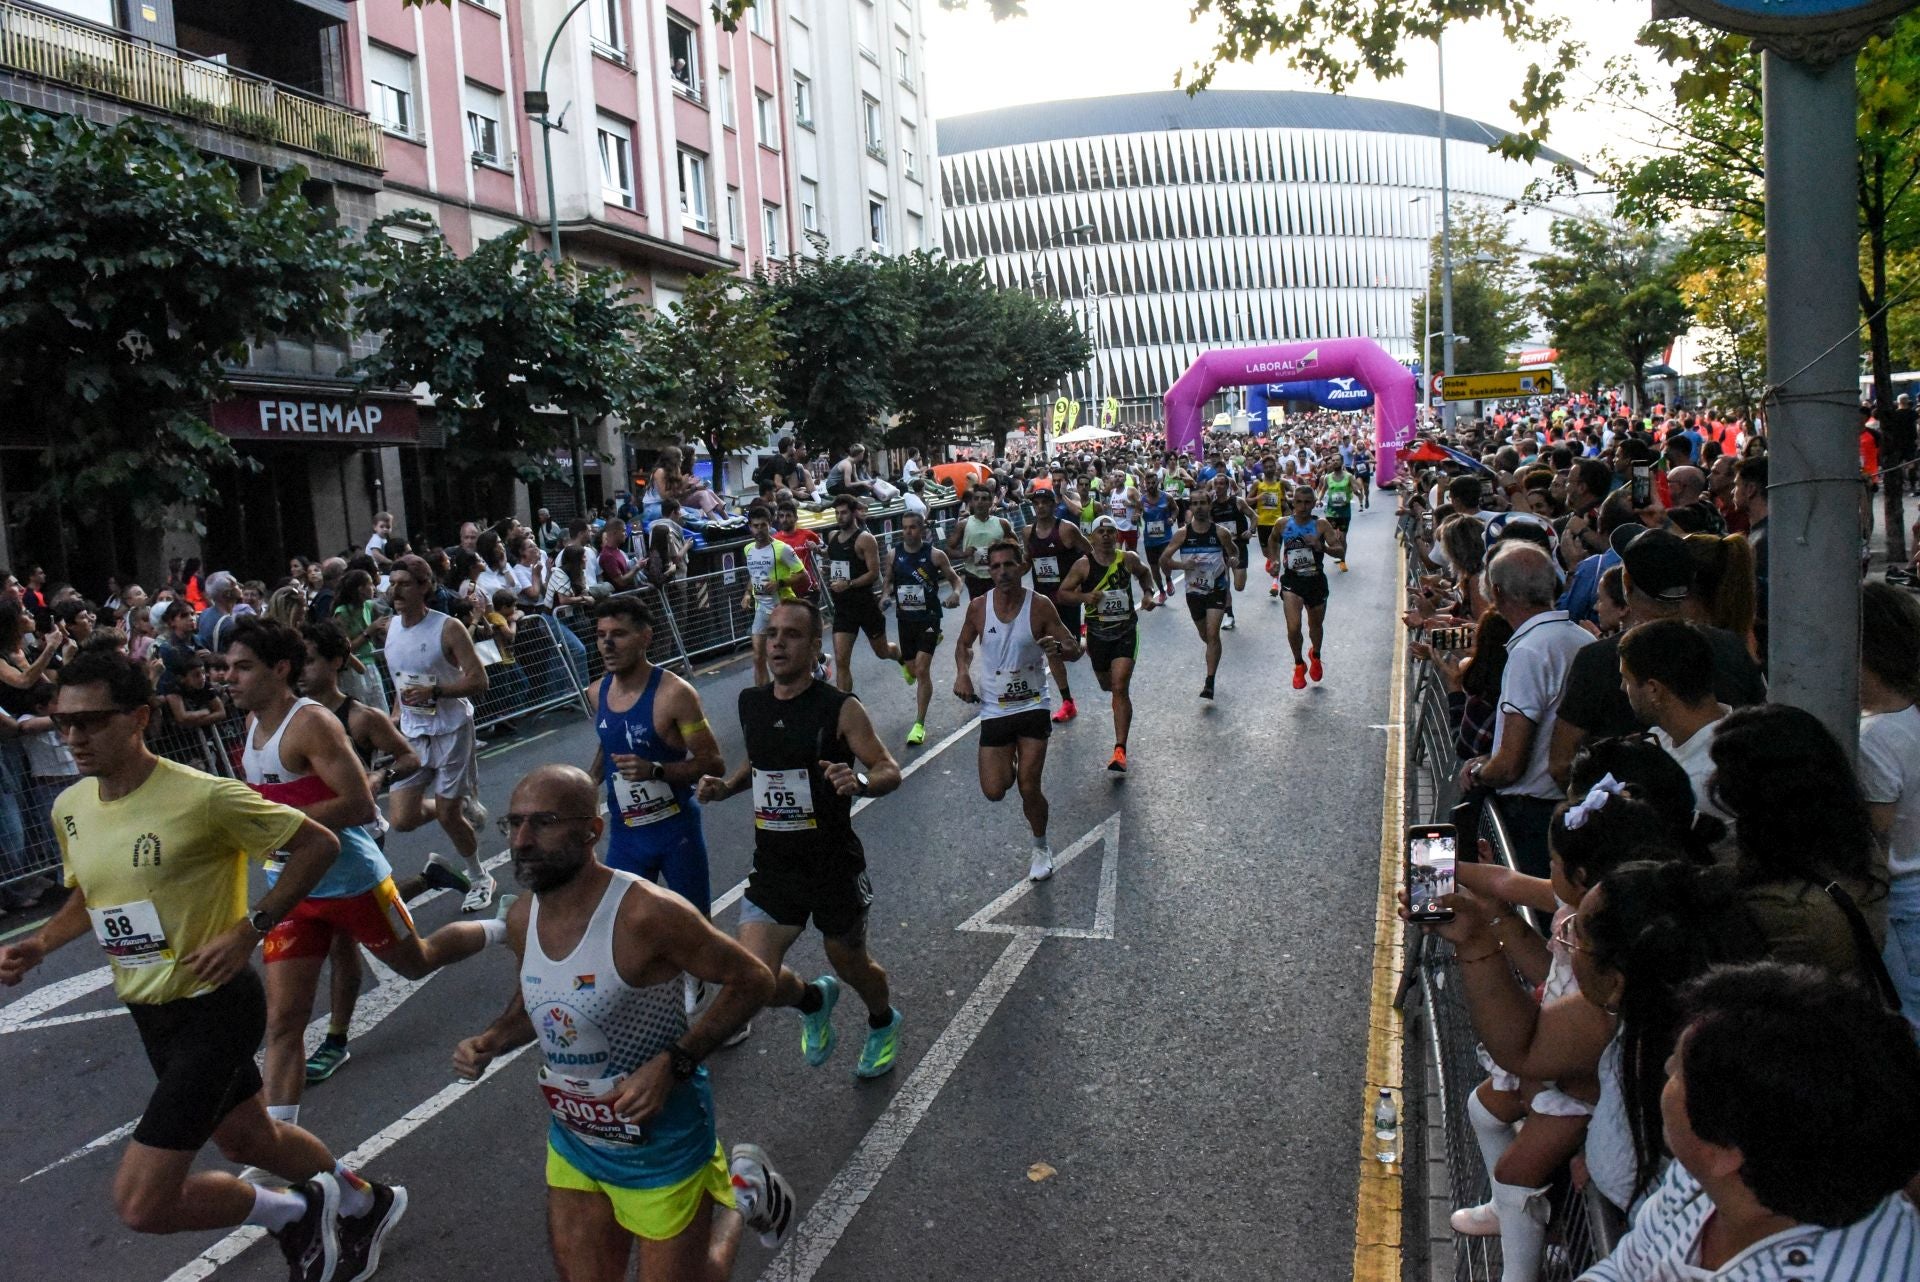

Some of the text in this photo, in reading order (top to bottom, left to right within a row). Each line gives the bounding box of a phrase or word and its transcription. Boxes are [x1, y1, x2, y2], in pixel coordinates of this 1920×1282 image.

[1246, 360, 1295, 373] LABORAL
[1327, 389, 1368, 399] MIZUNO
[259, 400, 382, 434] FREMAP
[1006, 681, 1028, 693] 258
[630, 787, 650, 804] 51
[764, 791, 796, 807] 195
[104, 916, 134, 938] 88
[546, 1051, 609, 1065] MADRID
